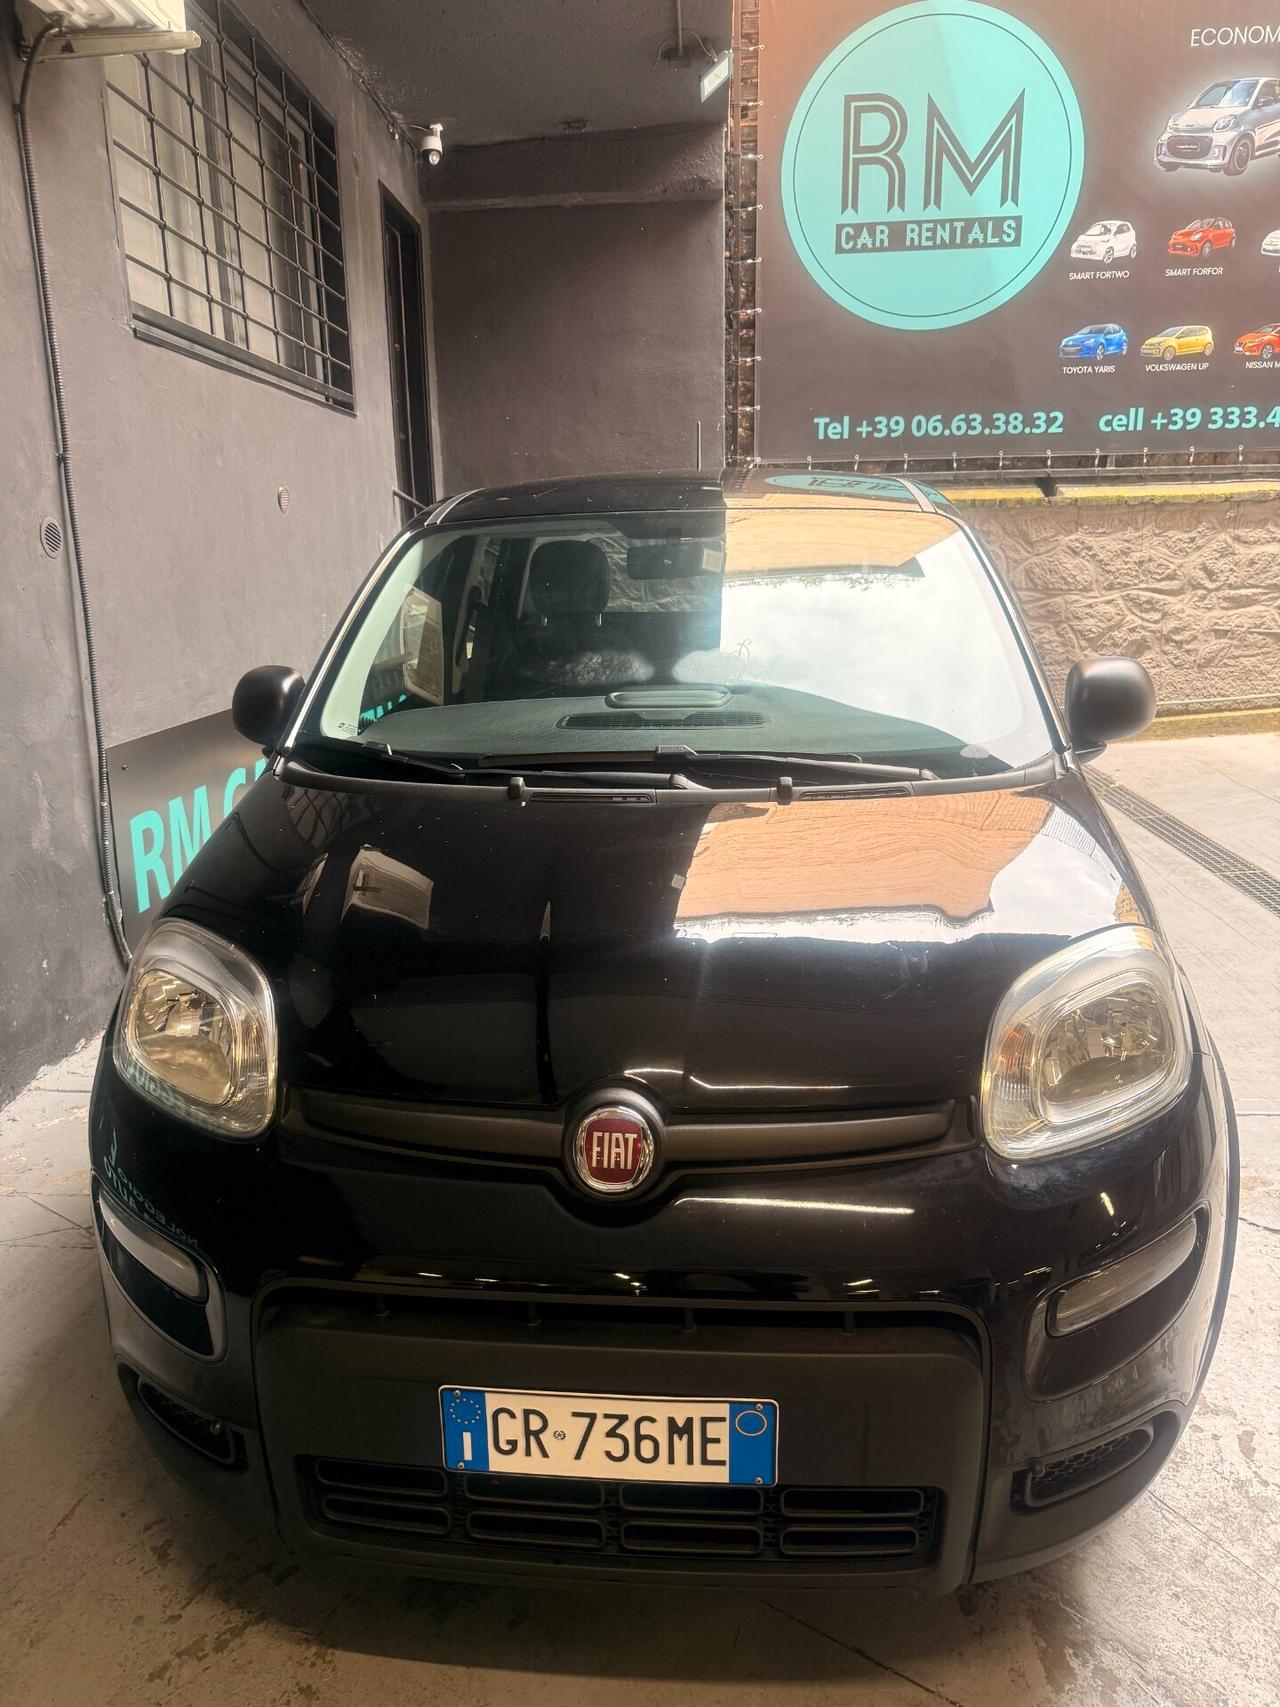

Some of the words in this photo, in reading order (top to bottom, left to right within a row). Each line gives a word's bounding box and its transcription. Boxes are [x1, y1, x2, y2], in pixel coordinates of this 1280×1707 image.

[1190, 26, 1280, 47] ECONOM
[841, 87, 1026, 216] RM
[841, 225, 889, 249] CAR
[905, 219, 1016, 247] RENTALS
[1069, 272, 1094, 280] SMART
[1096, 271, 1130, 280] FORTWO
[1165, 269, 1190, 277] SMART
[1192, 267, 1223, 276] FORFOR
[1063, 366, 1092, 375] TOYOTA
[1094, 365, 1115, 374] YARIS
[1145, 363, 1197, 372] VOLKSWAGEN
[1198, 362, 1210, 371] UP
[1245, 361, 1273, 370] NISSAN
[813, 416, 849, 440] Tel
[856, 415, 905, 438] +39
[911, 411, 1064, 437] 06.63.38.32
[1099, 407, 1144, 432] cell
[1151, 407, 1202, 430] +39
[1208, 406, 1280, 430] 333.4
[130, 784, 212, 914] RM
[592, 1131, 638, 1170] FIAT
